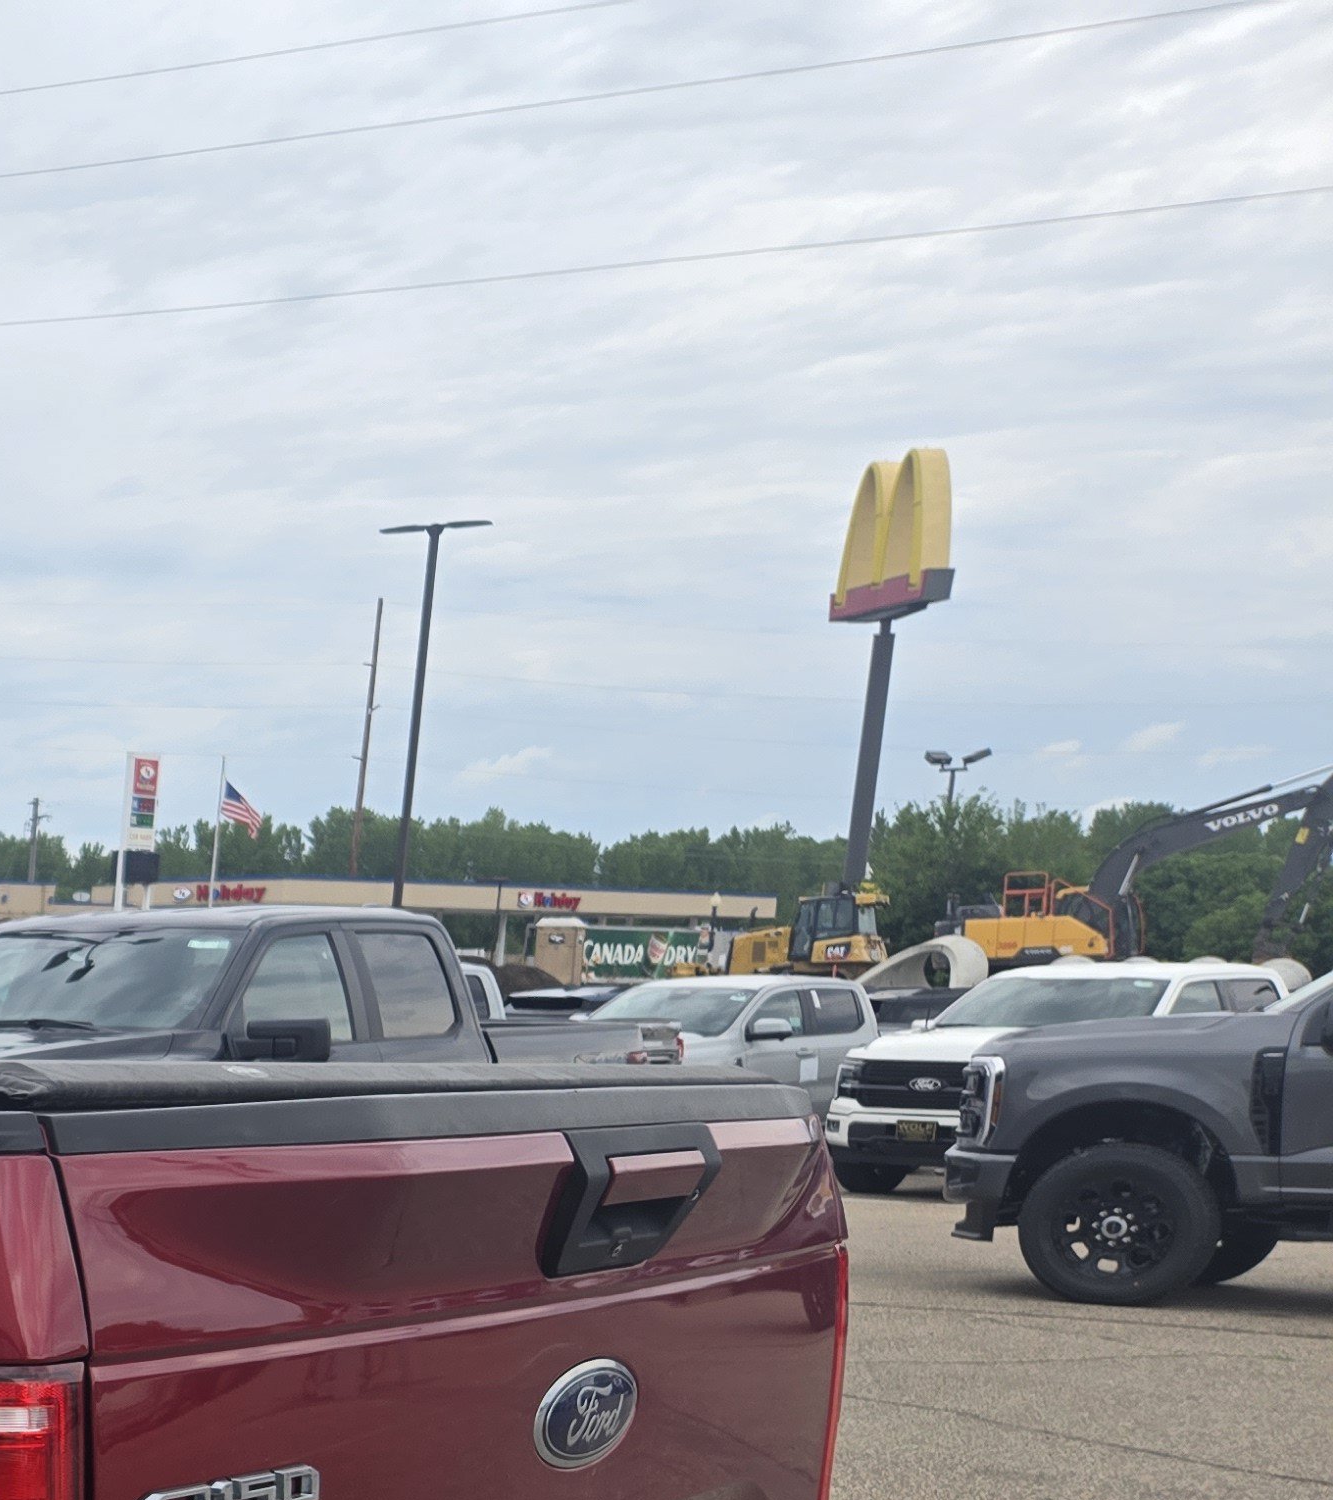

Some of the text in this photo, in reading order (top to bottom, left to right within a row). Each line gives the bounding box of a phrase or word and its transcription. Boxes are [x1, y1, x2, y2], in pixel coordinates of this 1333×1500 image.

[1203, 803, 1279, 832] VOLVO
[583, 940, 644, 966] CANADA
[664, 945, 698, 966] DRY
[827, 945, 847, 960] CAT
[566, 1385, 625, 1448] Ford
